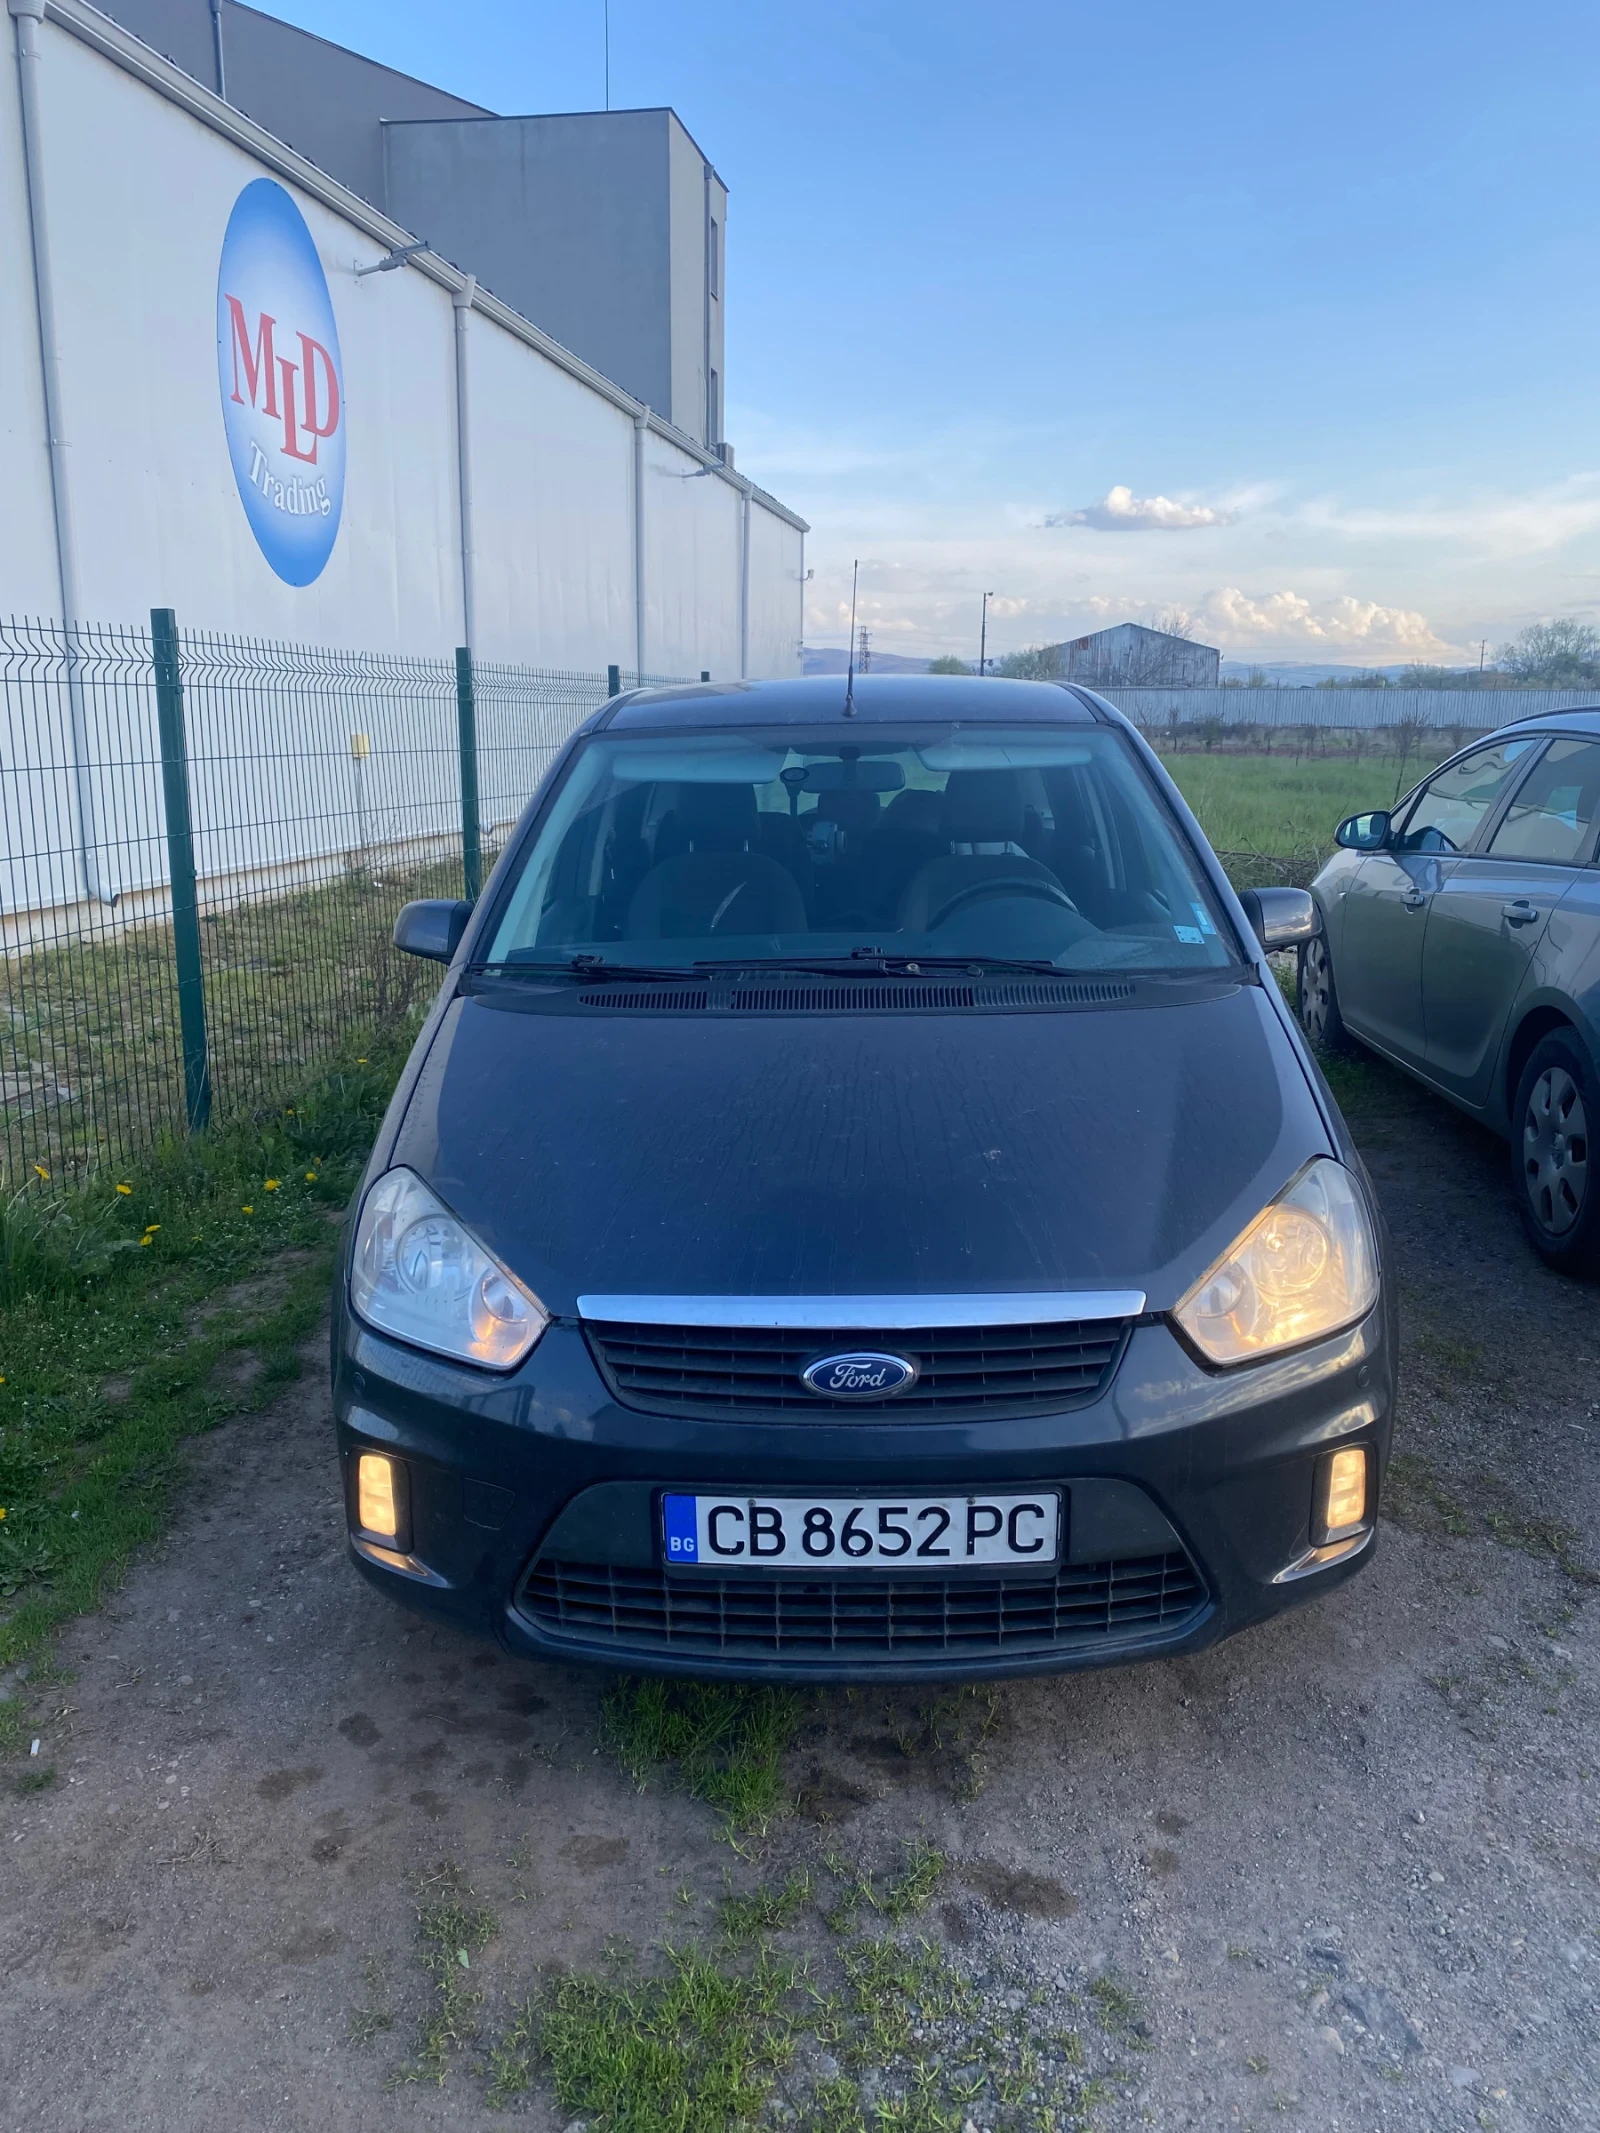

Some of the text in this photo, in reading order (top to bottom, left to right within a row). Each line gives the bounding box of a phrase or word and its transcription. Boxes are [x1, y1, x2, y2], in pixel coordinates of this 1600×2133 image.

[249, 440, 331, 517] Trading
[829, 1363, 886, 1388] Ford
[670, 1536, 695, 1552] BG
[802, 1505, 951, 1557] 8652
